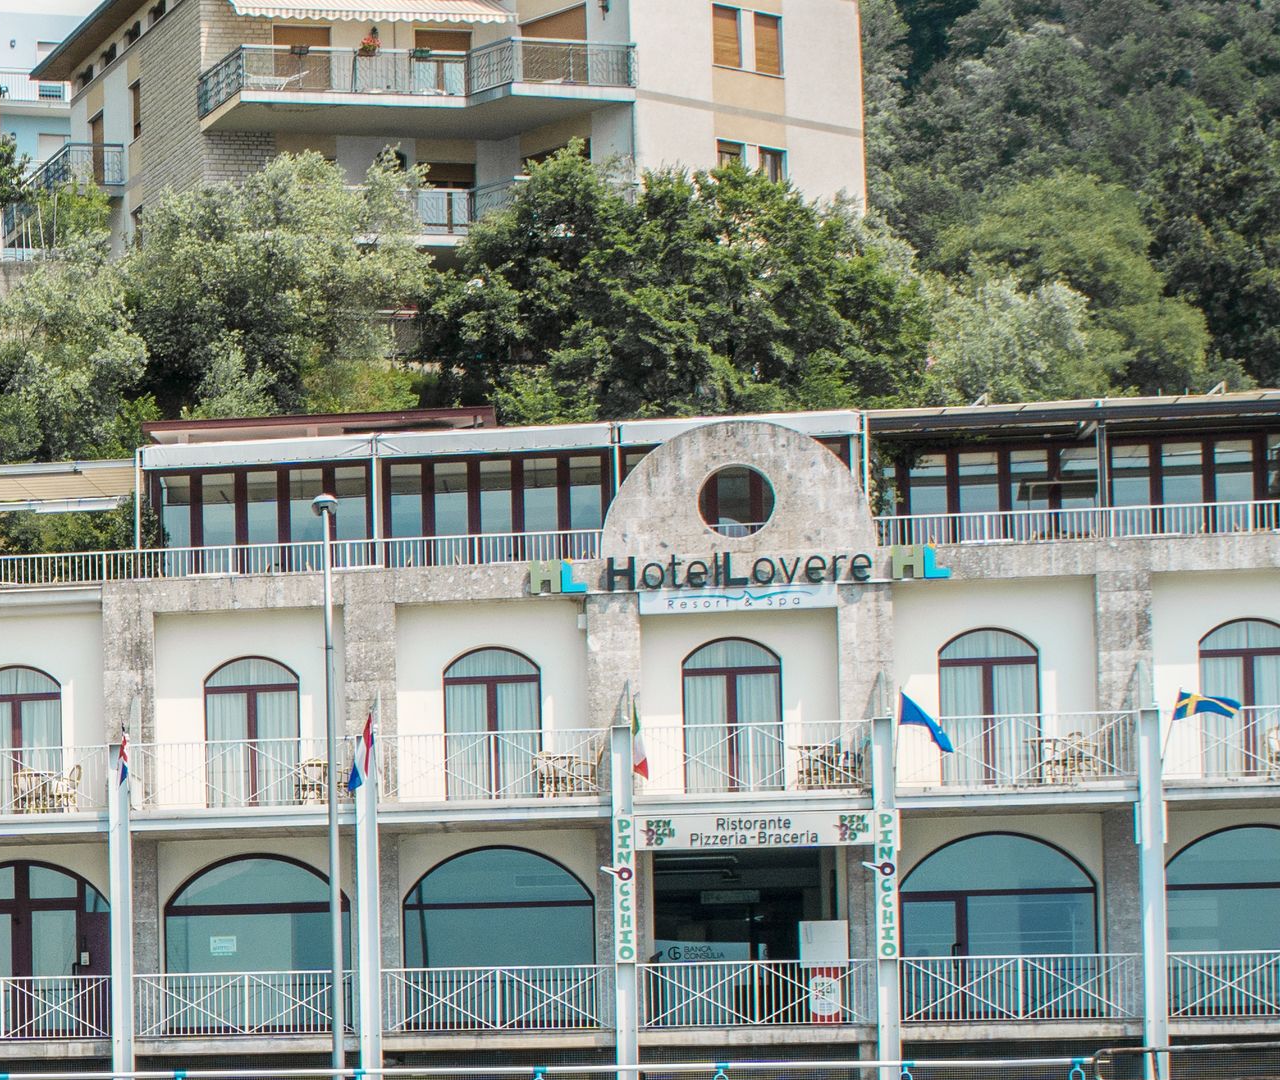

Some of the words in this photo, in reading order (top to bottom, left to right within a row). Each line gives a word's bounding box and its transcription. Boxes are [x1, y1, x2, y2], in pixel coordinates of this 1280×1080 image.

[606, 552, 872, 591] HotelLovere
[667, 597, 730, 610] Resort
[744, 597, 753, 607] &
[766, 596, 801, 608] Spa
[715, 816, 791, 831] Ristorante
[617, 819, 634, 960] PINOCCHIO
[879, 813, 896, 957] PINOCCHIO
[683, 945, 712, 953] BANCA
